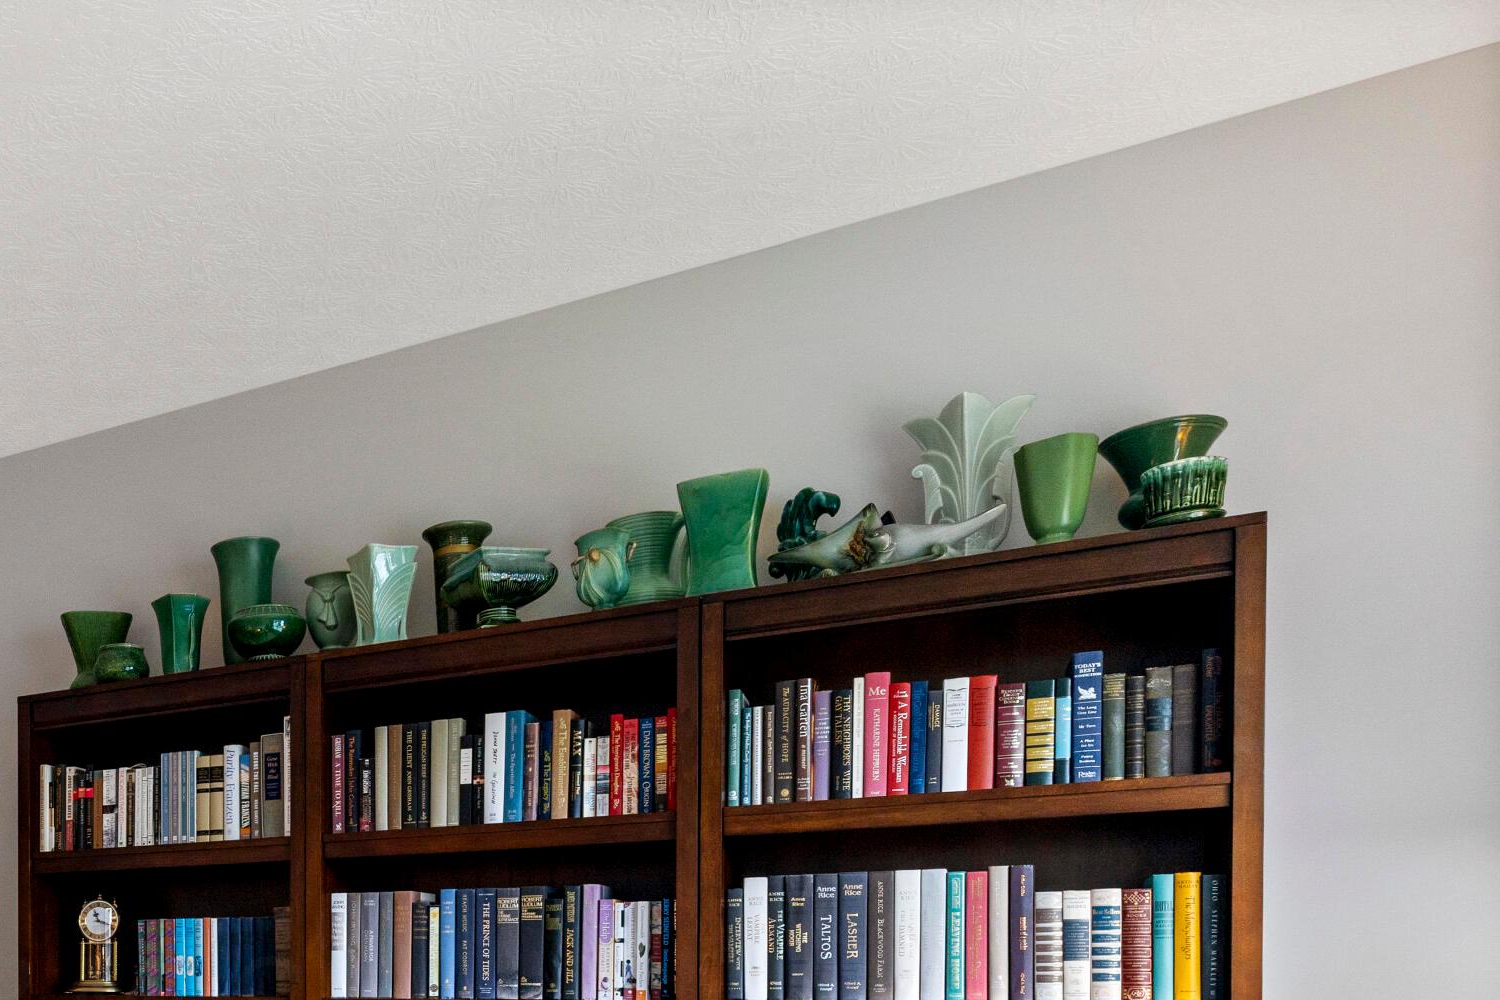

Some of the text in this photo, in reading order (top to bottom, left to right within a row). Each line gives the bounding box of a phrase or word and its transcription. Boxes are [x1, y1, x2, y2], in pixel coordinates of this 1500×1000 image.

[782, 688, 790, 697] The
[800, 685, 809, 737] Ina Garten
[868, 686, 886, 696] Me
[782, 698, 790, 733] AUDACITY
[896, 712, 908, 754] Remarkable
[558, 730, 568, 796] The Establishment
[572, 730, 582, 756] MAX
[782, 743, 790, 763] HOPE
[872, 708, 881, 781] KATHARINE HEPBURN
[226, 750, 235, 824] Purity Franzen
[896, 756, 908, 782] Woman
[332, 800, 341, 817] KILL
[334, 790, 341, 799] TO
[482, 903, 490, 981] THE PRINCE OF TIDES
[600, 912, 610, 939] The Help
[820, 914, 832, 960] TALTOS
[846, 913, 858, 959] LASHER
[566, 928, 574, 984] JACK AND JILL
[951, 912, 960, 989] LEAVING HOME
